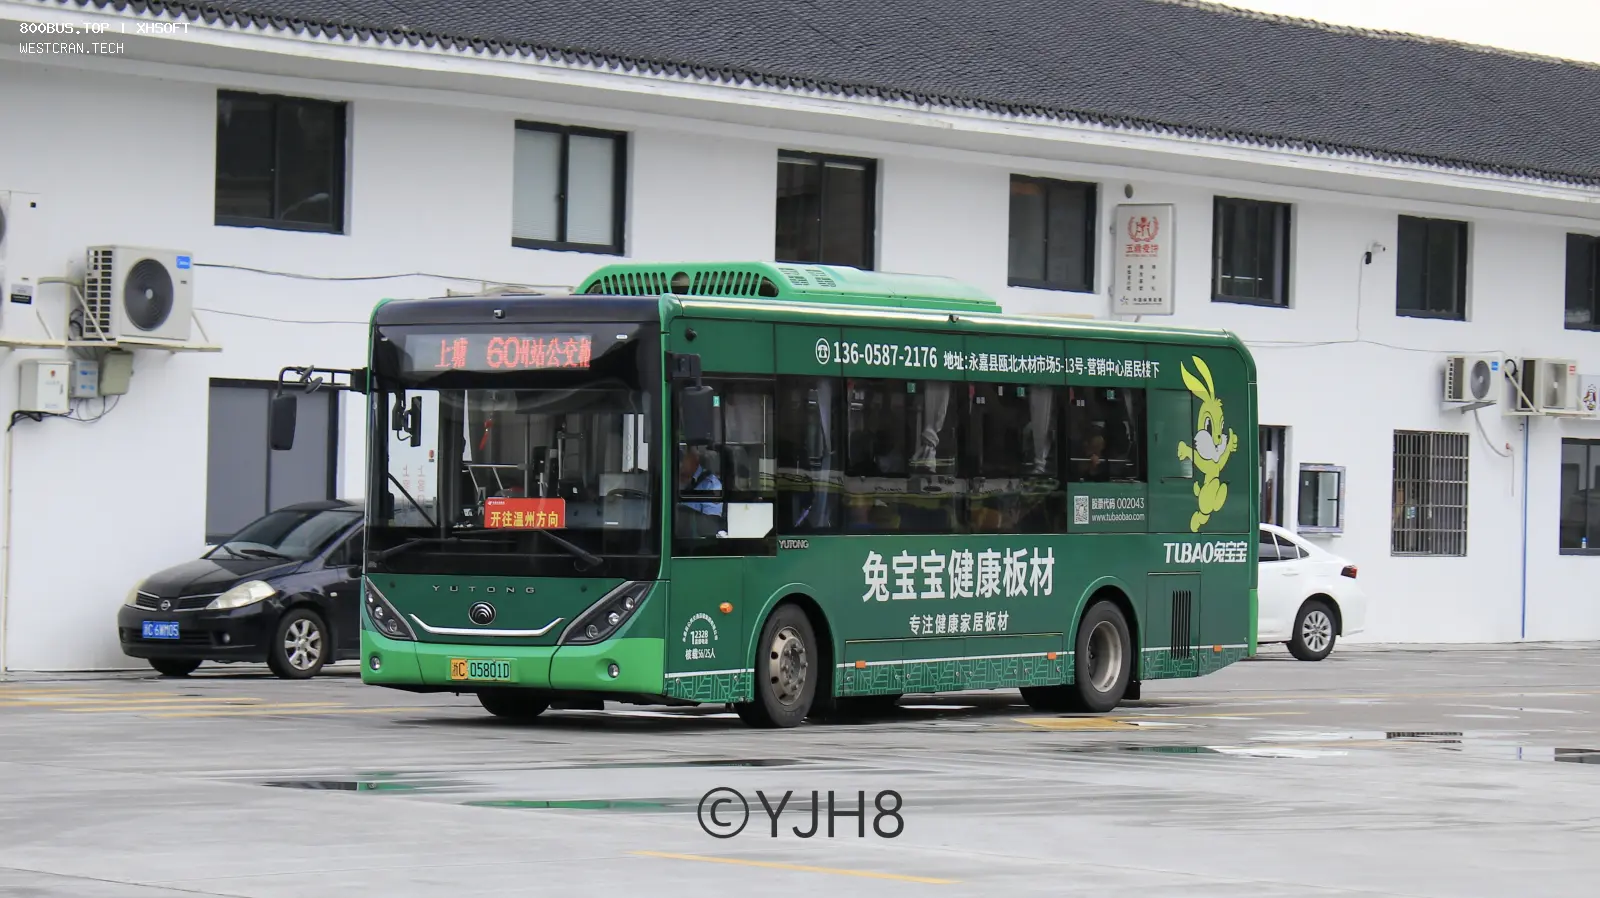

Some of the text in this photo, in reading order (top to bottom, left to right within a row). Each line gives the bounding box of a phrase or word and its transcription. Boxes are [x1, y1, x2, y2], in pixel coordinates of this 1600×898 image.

[833, 341, 938, 368] 136-0587-2176
[1091, 497, 1145, 510] 股票代码 002043
[490, 510, 559, 528] 开往温州方向
[1091, 511, 1146, 522] www.tubaobao.com
[779, 539, 809, 549] YUTONG
[861, 547, 1055, 602] 兔宝宝健康板材
[432, 584, 536, 595] YUTONG
[908, 610, 1010, 635] 专注健康家居板材
